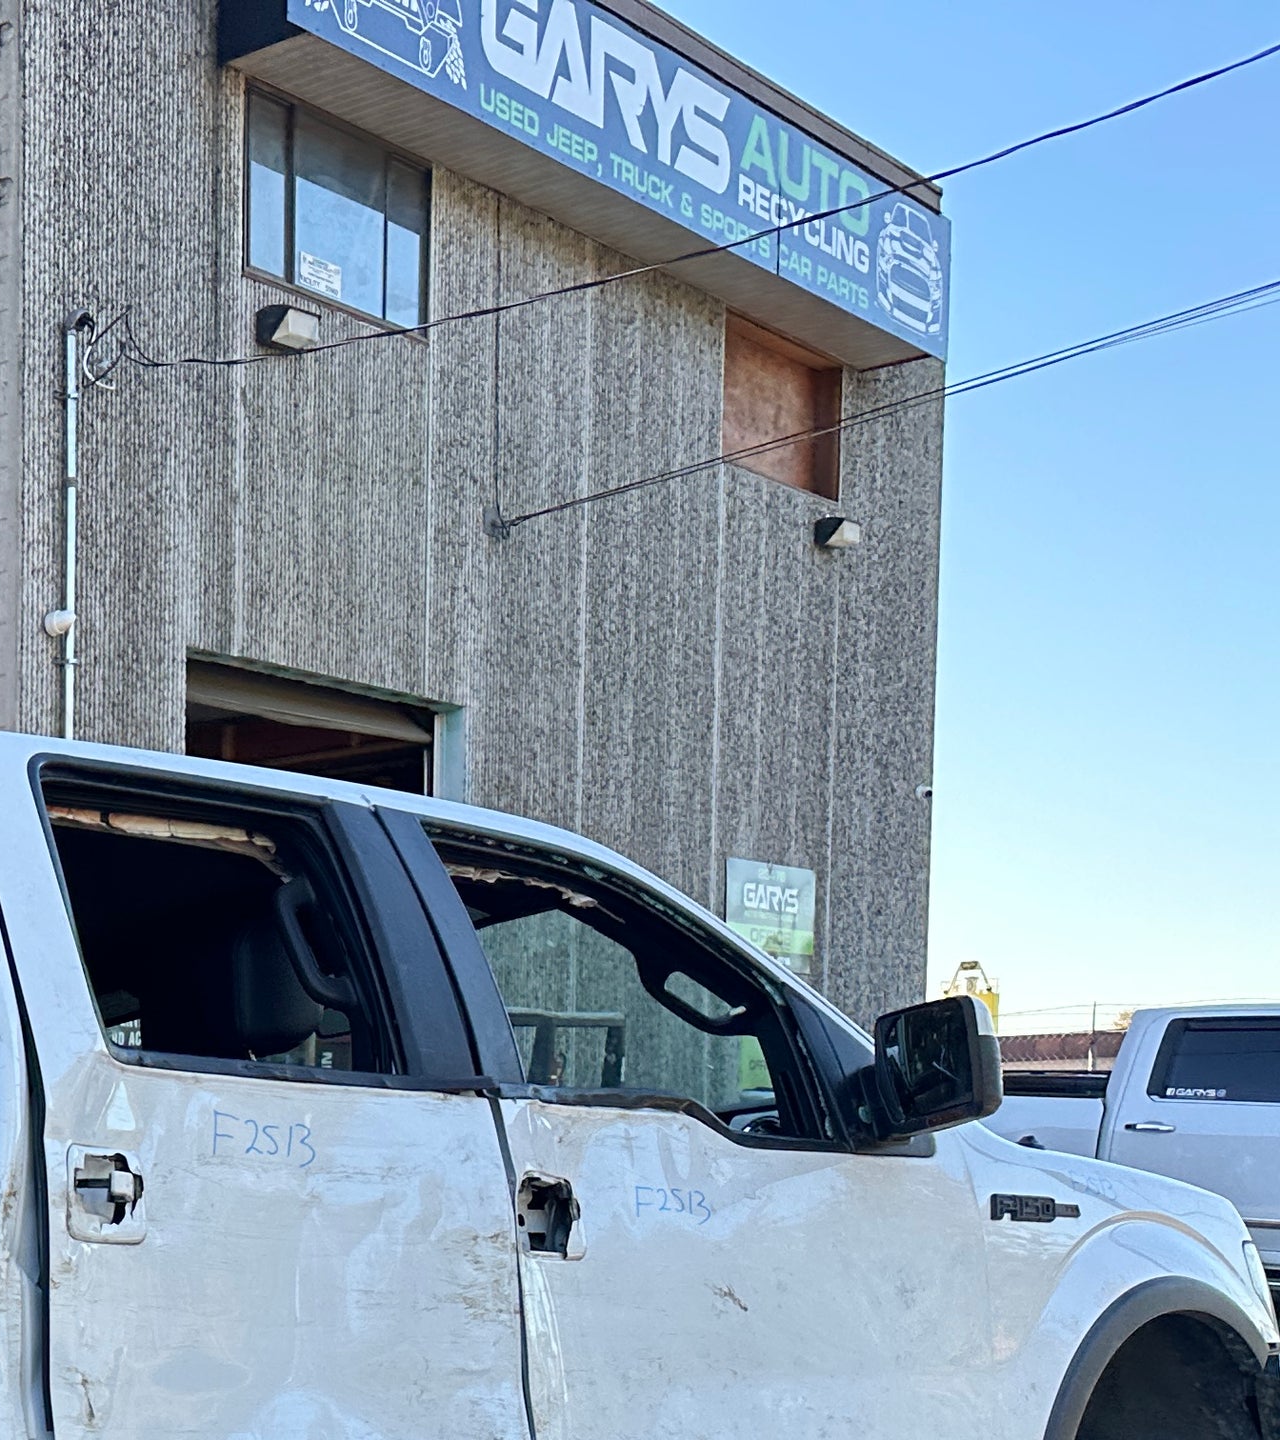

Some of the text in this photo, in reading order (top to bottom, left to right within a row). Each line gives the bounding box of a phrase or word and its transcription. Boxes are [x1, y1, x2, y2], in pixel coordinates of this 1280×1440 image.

[481, 0, 731, 195] GARYS
[479, 83, 870, 311] USED JEEP, TRUCK & SPORTS CAR PARTS
[737, 173, 870, 275] RECYCLING
[739, 114, 871, 237] AUTO
[743, 882, 799, 914] GARYS
[212, 1109, 316, 1168] F2513
[634, 1185, 712, 1226] F2513
